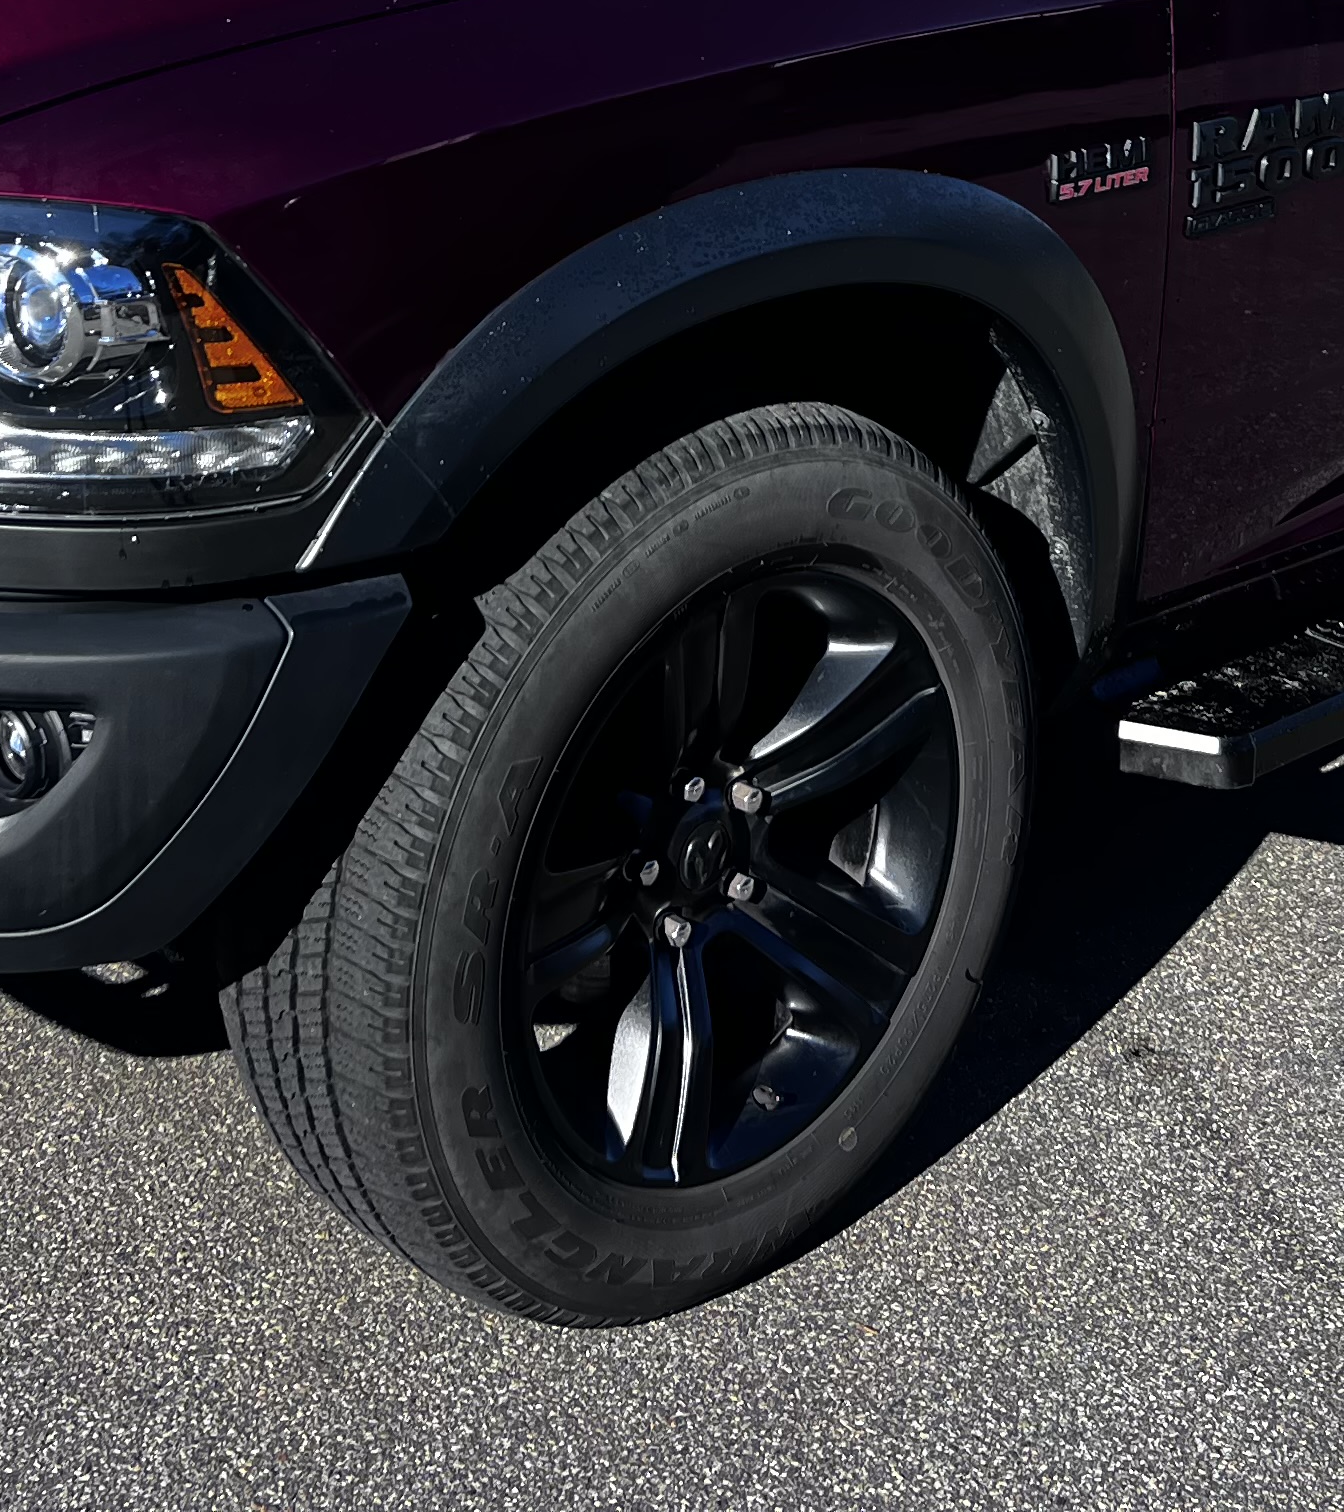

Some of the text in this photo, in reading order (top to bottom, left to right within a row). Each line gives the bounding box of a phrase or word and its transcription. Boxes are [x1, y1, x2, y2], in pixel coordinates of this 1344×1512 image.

[1047, 136, 1150, 184] HEMI
[1059, 166, 1150, 201] 5.7 LITER
[825, 487, 1027, 867] GOODYEAR
